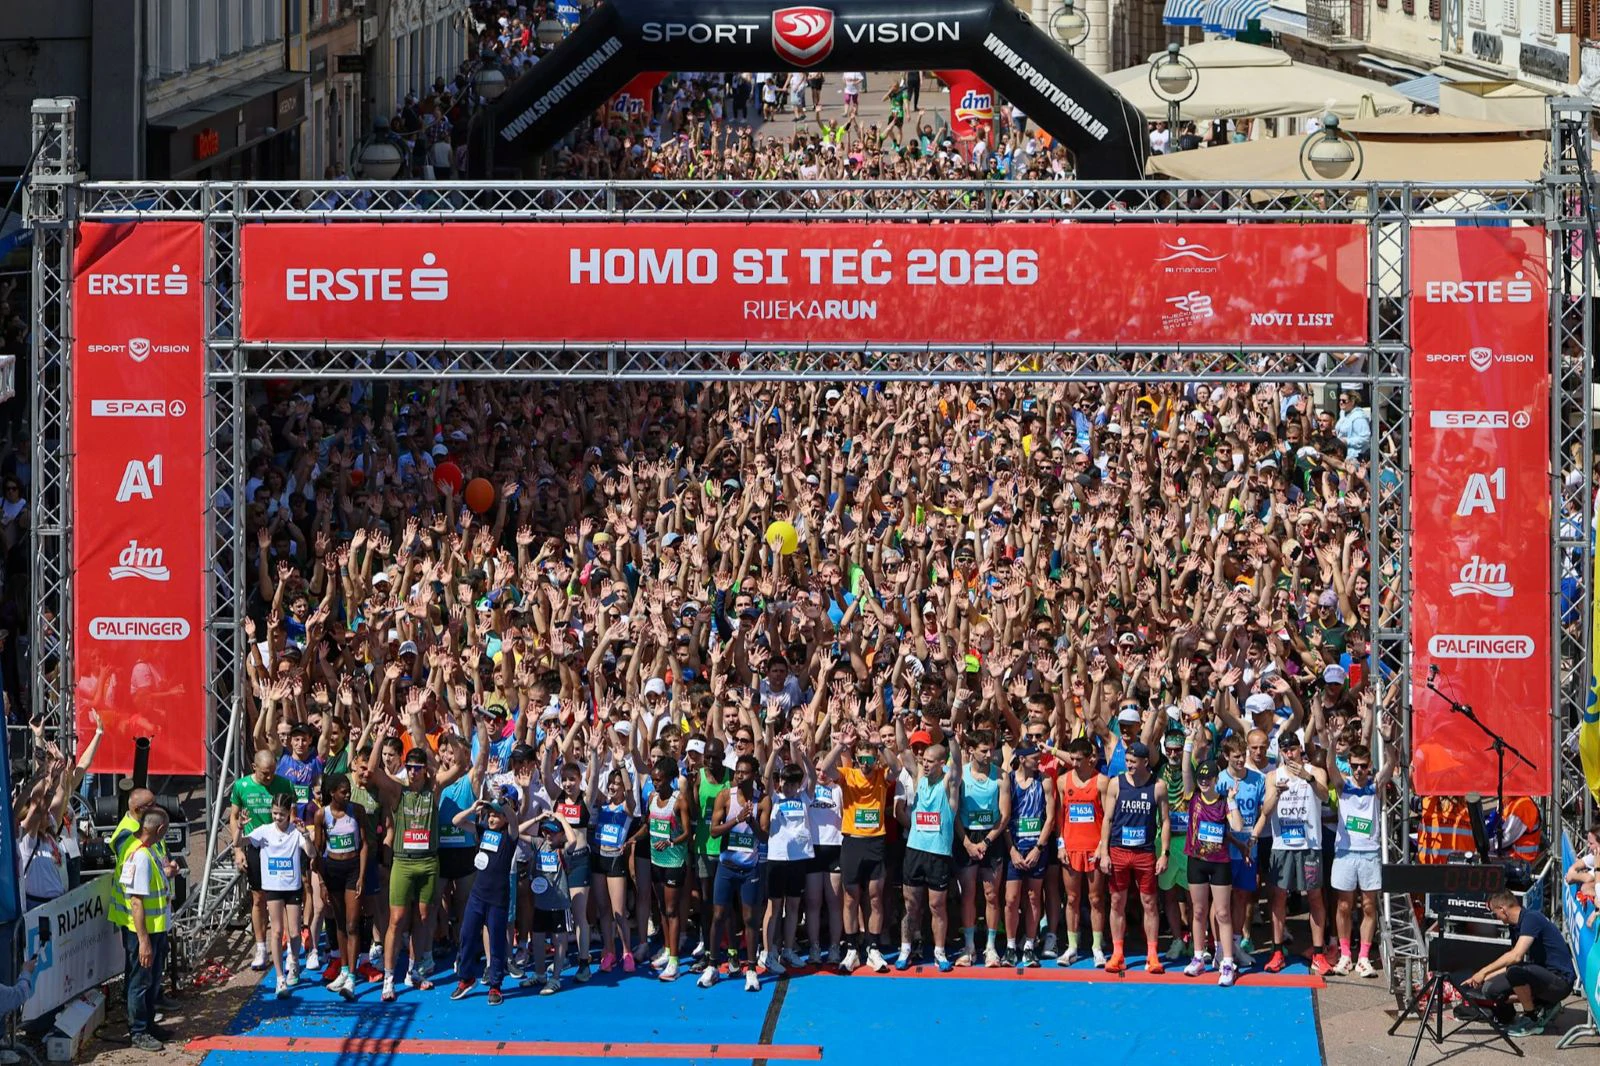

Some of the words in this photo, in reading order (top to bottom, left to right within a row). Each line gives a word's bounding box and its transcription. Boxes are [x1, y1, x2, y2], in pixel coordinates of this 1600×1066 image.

[642, 22, 760, 44] SPORT
[844, 22, 960, 44] VISION
[500, 36, 623, 142] WWW.SPORTVISION.HR
[983, 32, 1110, 141] WWW.SPORTVISION.HR
[960, 90, 991, 110] dm
[570, 248, 718, 284] HOMO
[732, 248, 789, 284] SI
[800, 240, 892, 285] TEĆ
[907, 248, 1039, 285] 2026
[88, 274, 160, 296] ERSTE
[286, 268, 403, 301] ERSTE
[1426, 280, 1502, 303] ERSTE
[744, 300, 877, 320] RIJEKARUN
[1250, 313, 1293, 326] NOVI
[1298, 313, 1334, 326] LIST
[88, 344, 126, 352] SPORT
[152, 344, 190, 352] VISION
[106, 402, 165, 414] SPAR
[1446, 412, 1508, 426] SPAR
[116, 454, 163, 502] A1
[1456, 467, 1506, 516] A1
[118, 540, 163, 567] dm
[1460, 556, 1506, 583] dm
[96, 622, 183, 636] PALFINGER
[1436, 640, 1528, 654] PALFINGER
[1121, 800, 1151, 810] ZAGREB
[1026, 821, 1038, 830] 197
[738, 836, 752, 845] 502
[58, 896, 104, 937] RIJEKA
